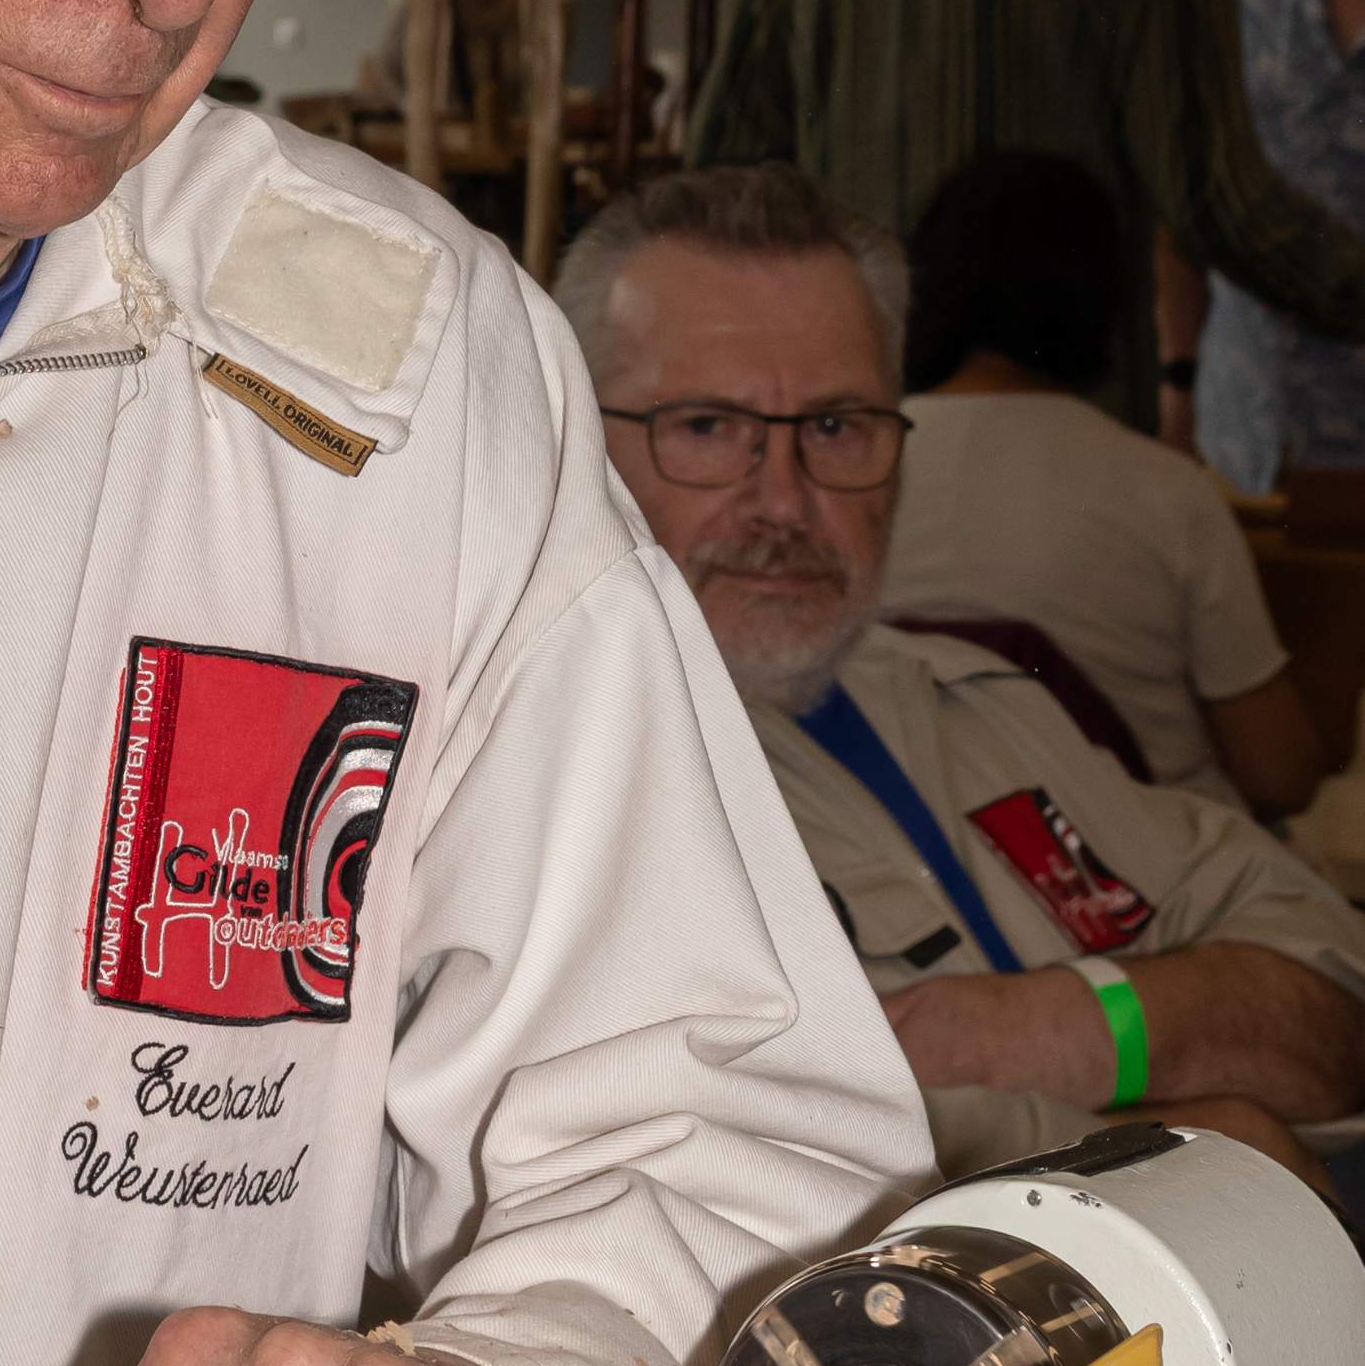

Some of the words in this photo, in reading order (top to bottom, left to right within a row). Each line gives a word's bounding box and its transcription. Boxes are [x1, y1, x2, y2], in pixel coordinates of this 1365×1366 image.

[223, 363, 281, 410] LOVELL
[283, 404, 354, 458] ORIGINAL
[96, 735, 149, 986] KUNSTAMBACHTEN
[131, 651, 158, 722] HOUT
[165, 843, 269, 904] Gilde
[131, 1042, 296, 1122] Everard
